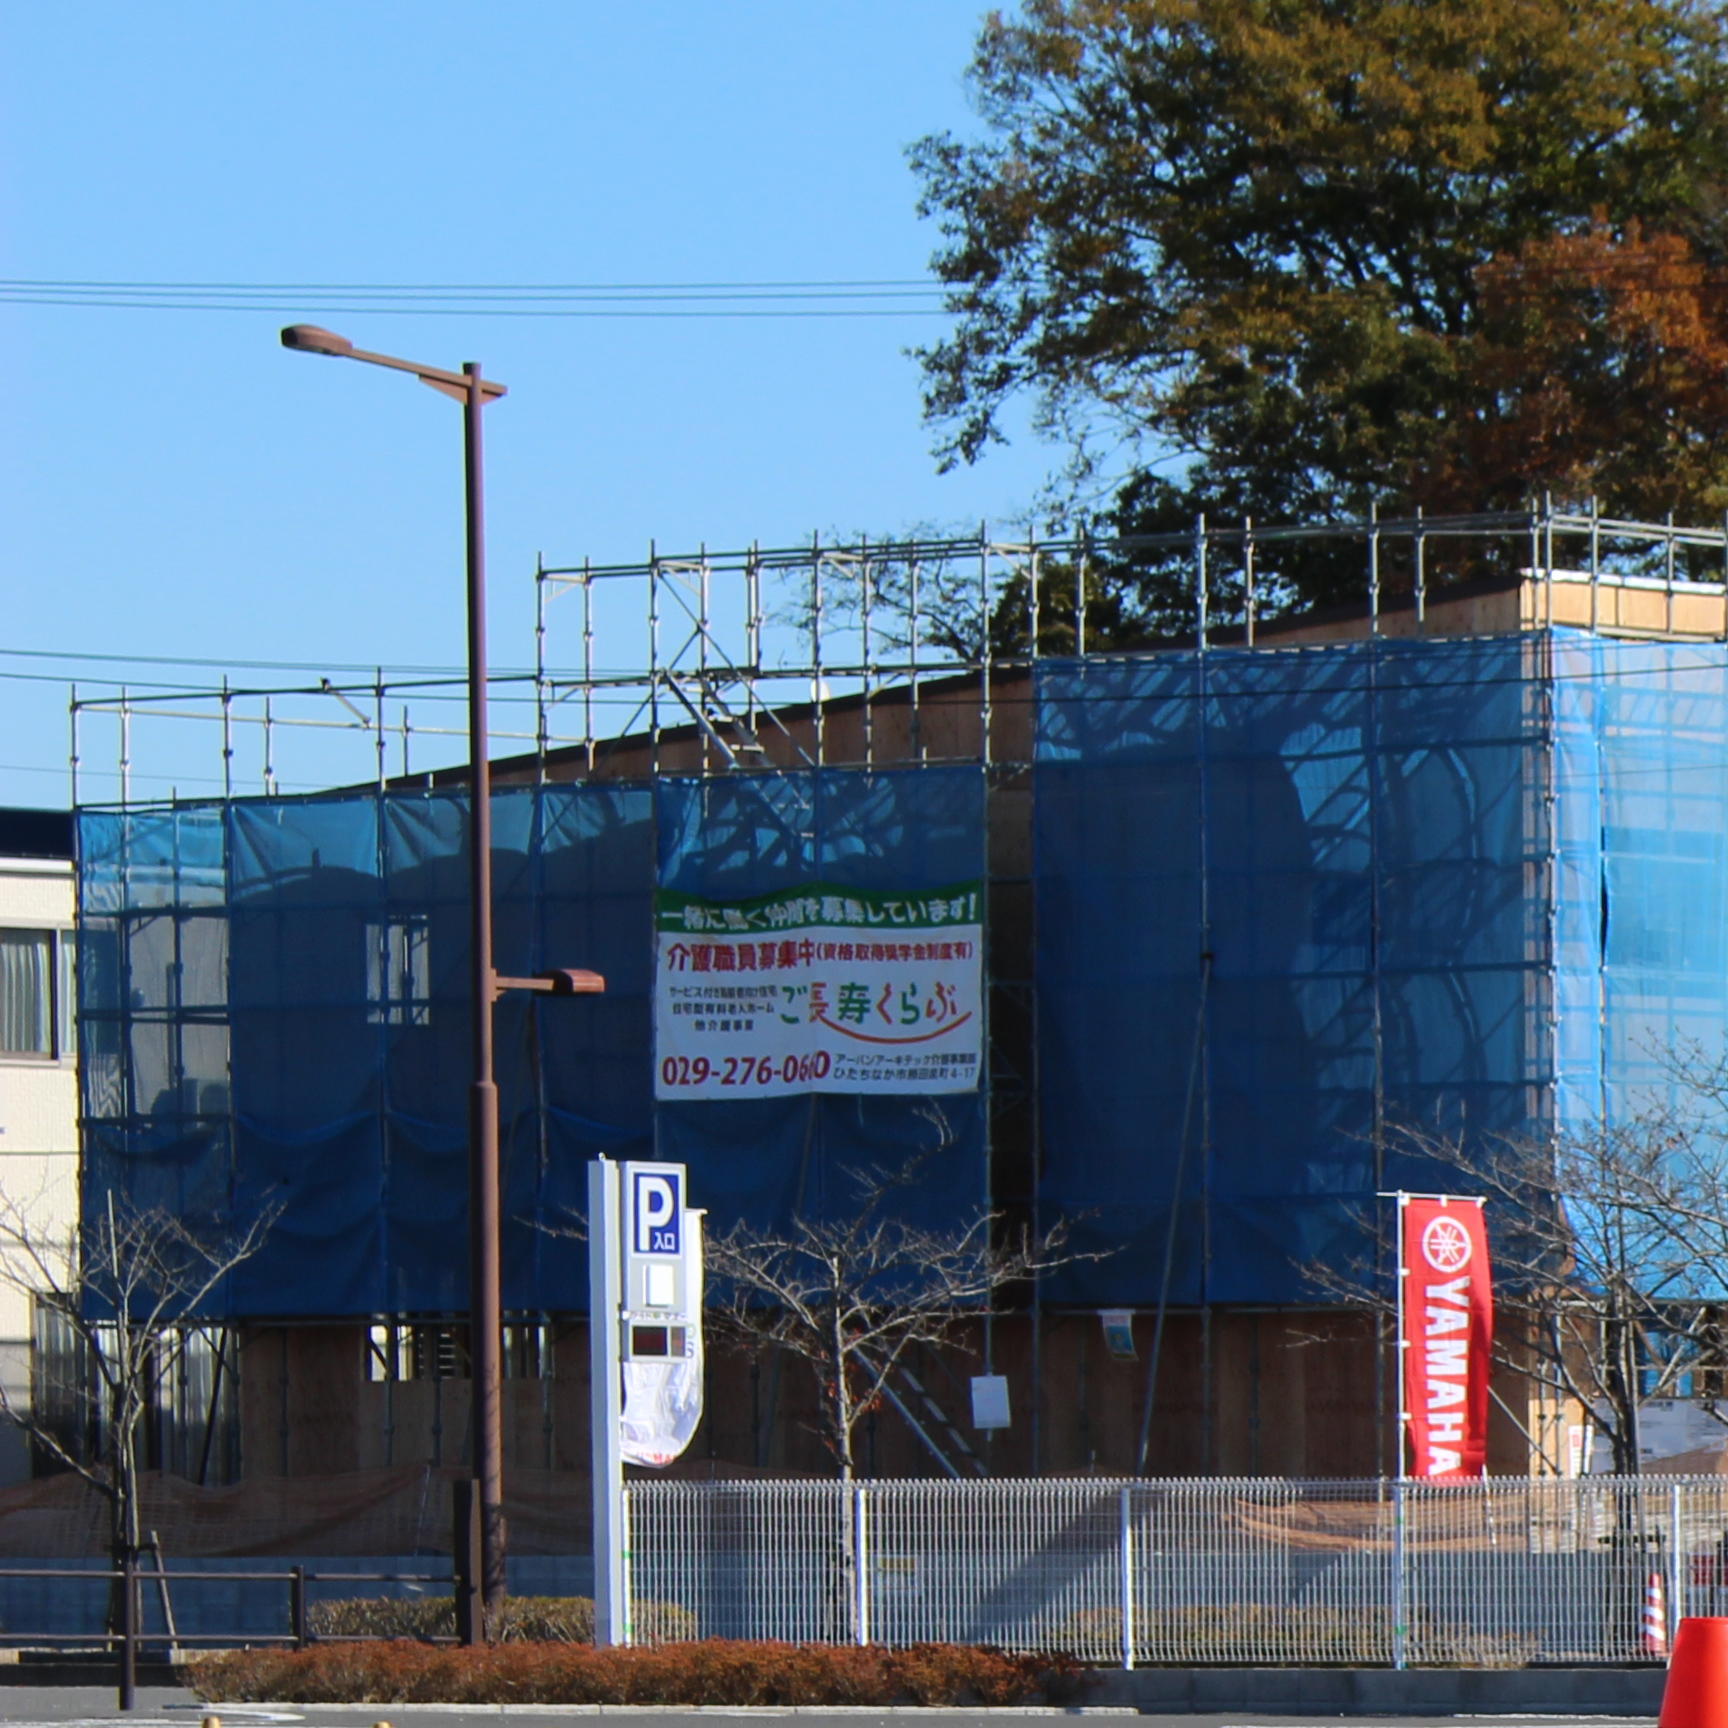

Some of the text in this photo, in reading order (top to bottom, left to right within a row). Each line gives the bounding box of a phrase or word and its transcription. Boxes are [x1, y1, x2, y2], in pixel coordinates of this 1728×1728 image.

[780, 982, 957, 1025] ご長寿くらぶ
[637, 1175, 675, 1252] P
[653, 1231, 676, 1250] 入口
[1424, 1275, 1470, 1475] YAMAHA
